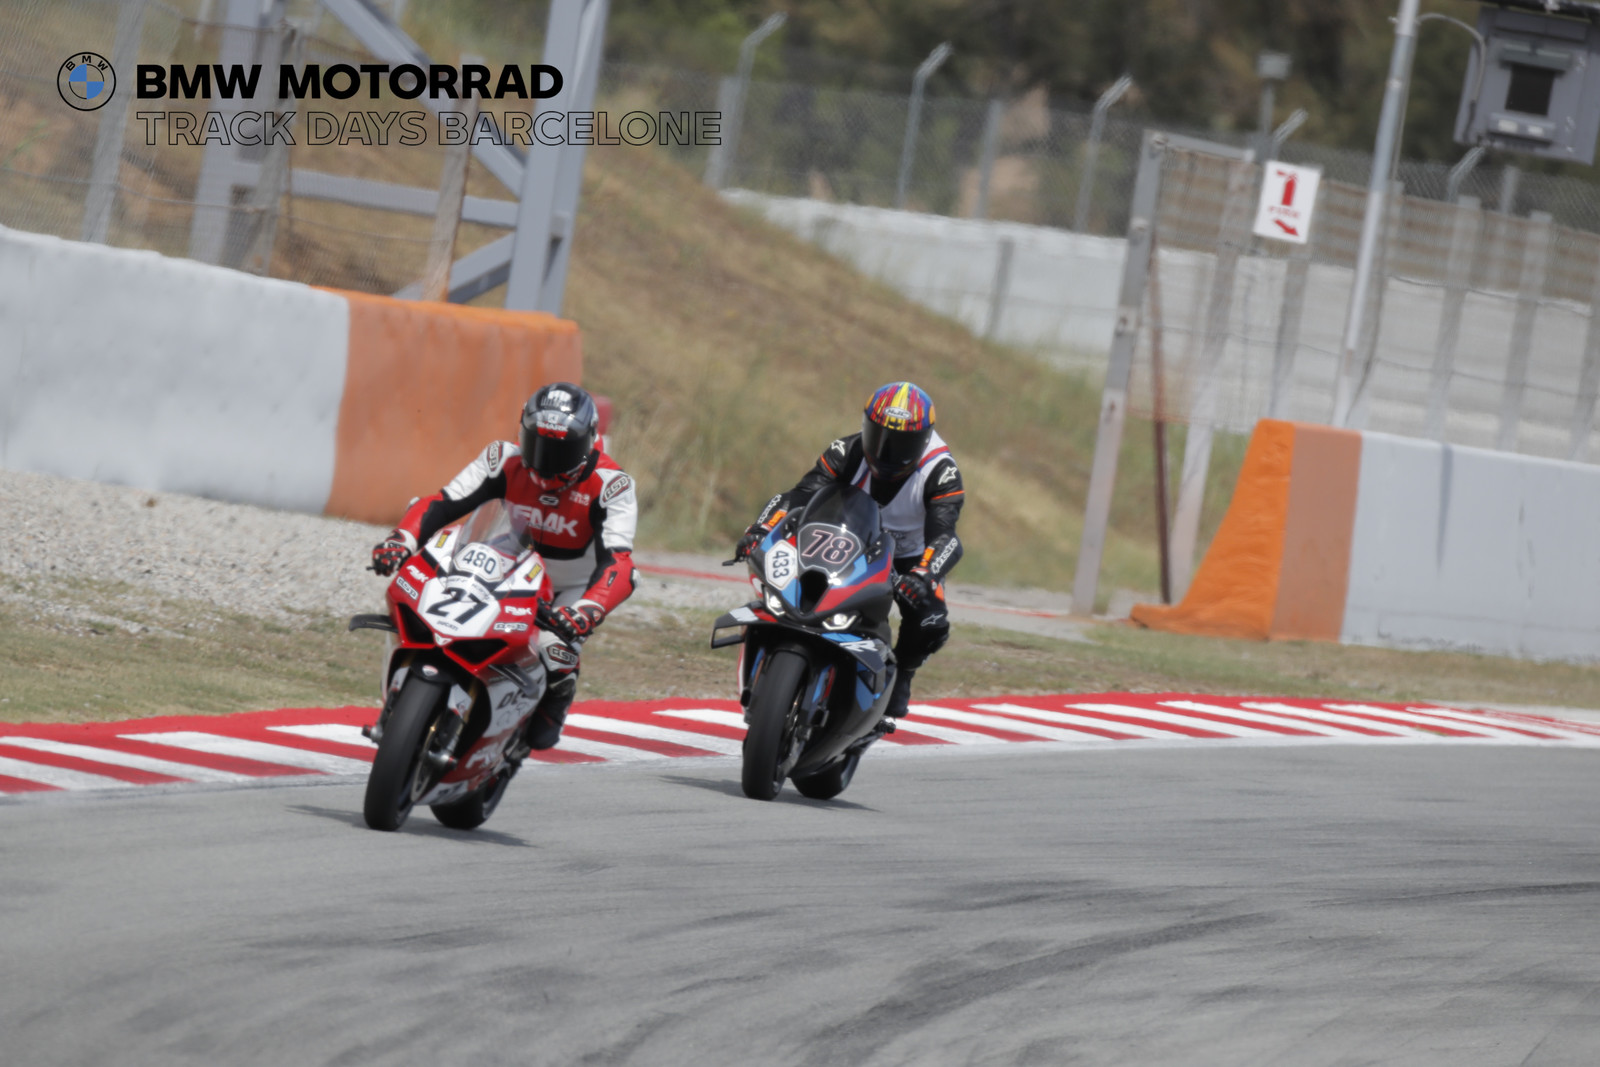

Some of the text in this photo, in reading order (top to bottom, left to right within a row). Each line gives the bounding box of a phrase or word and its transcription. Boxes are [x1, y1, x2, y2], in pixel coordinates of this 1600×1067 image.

[462, 549, 497, 575] 480
[802, 529, 853, 564] 78
[771, 549, 790, 579] 433
[425, 586, 489, 625] 27
